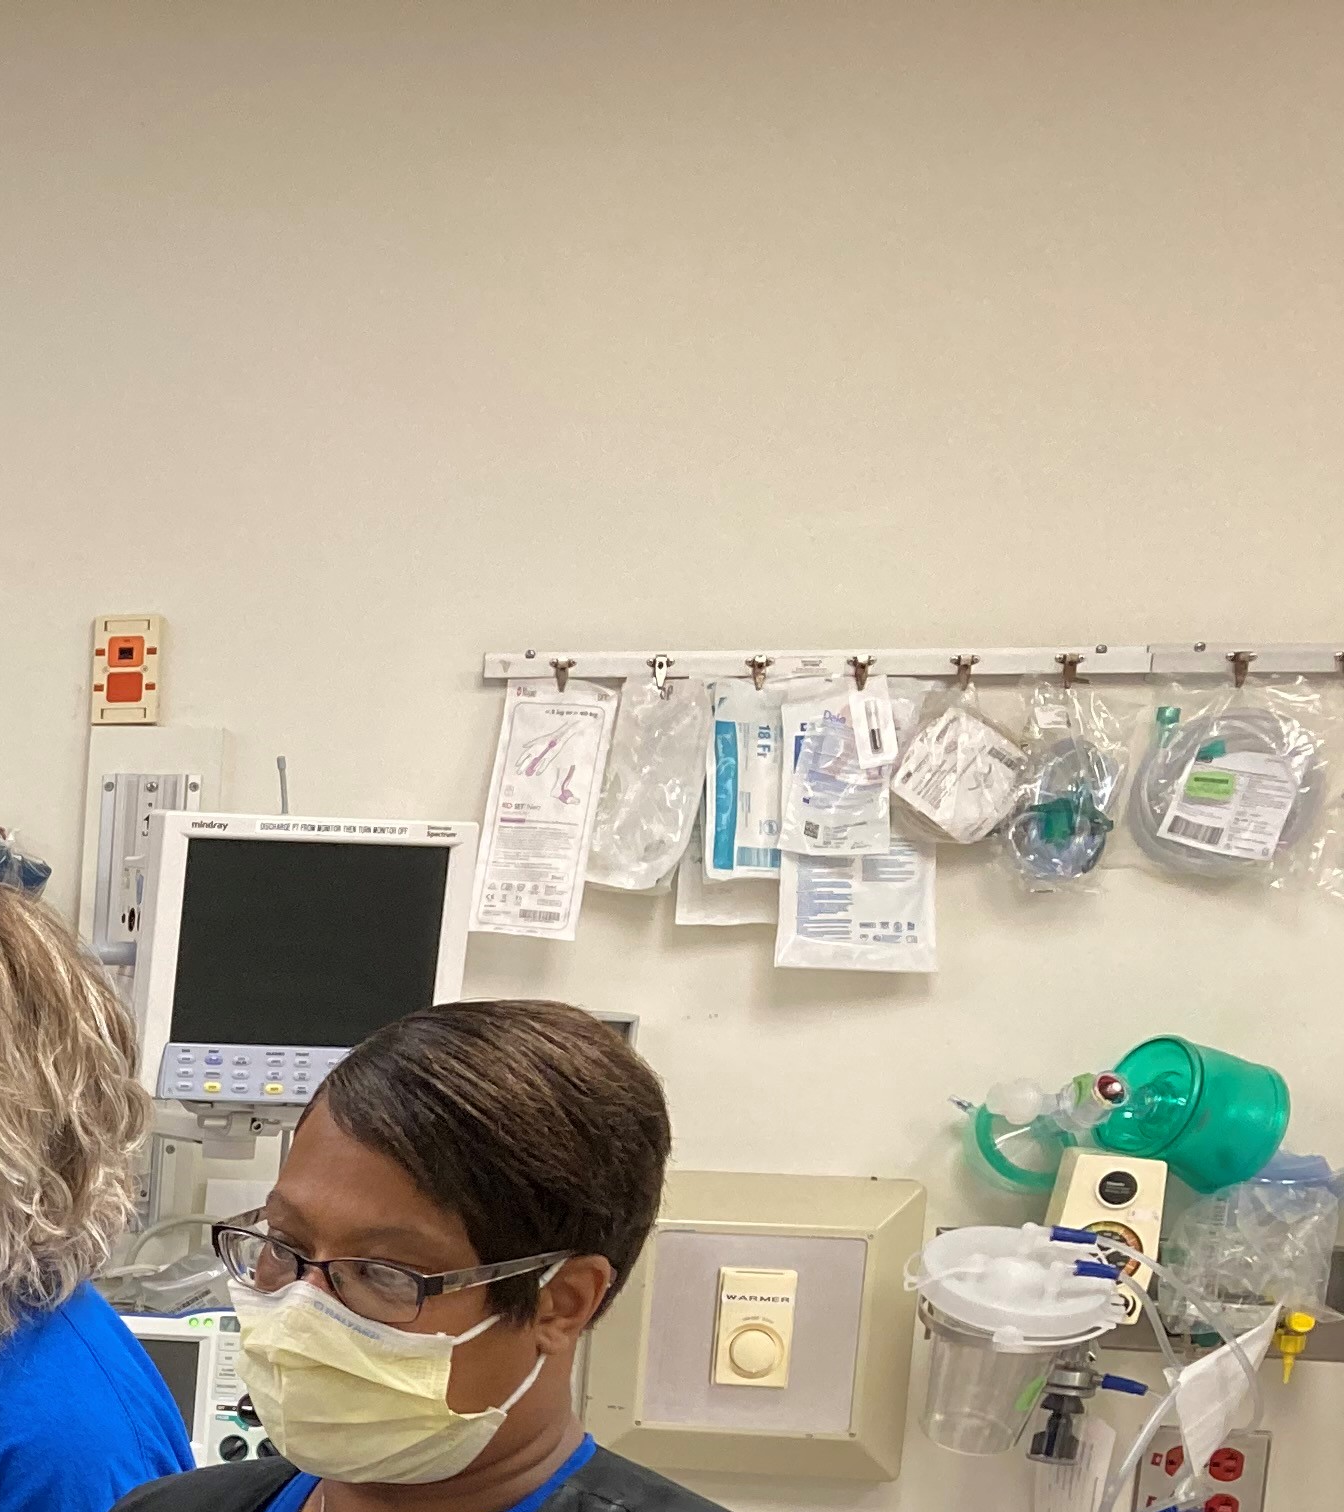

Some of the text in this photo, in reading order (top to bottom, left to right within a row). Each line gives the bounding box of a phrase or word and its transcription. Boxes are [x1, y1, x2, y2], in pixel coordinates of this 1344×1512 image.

[758, 724, 771, 739] 18
[191, 820, 229, 832] mindray
[726, 1293, 790, 1303] WARMER
